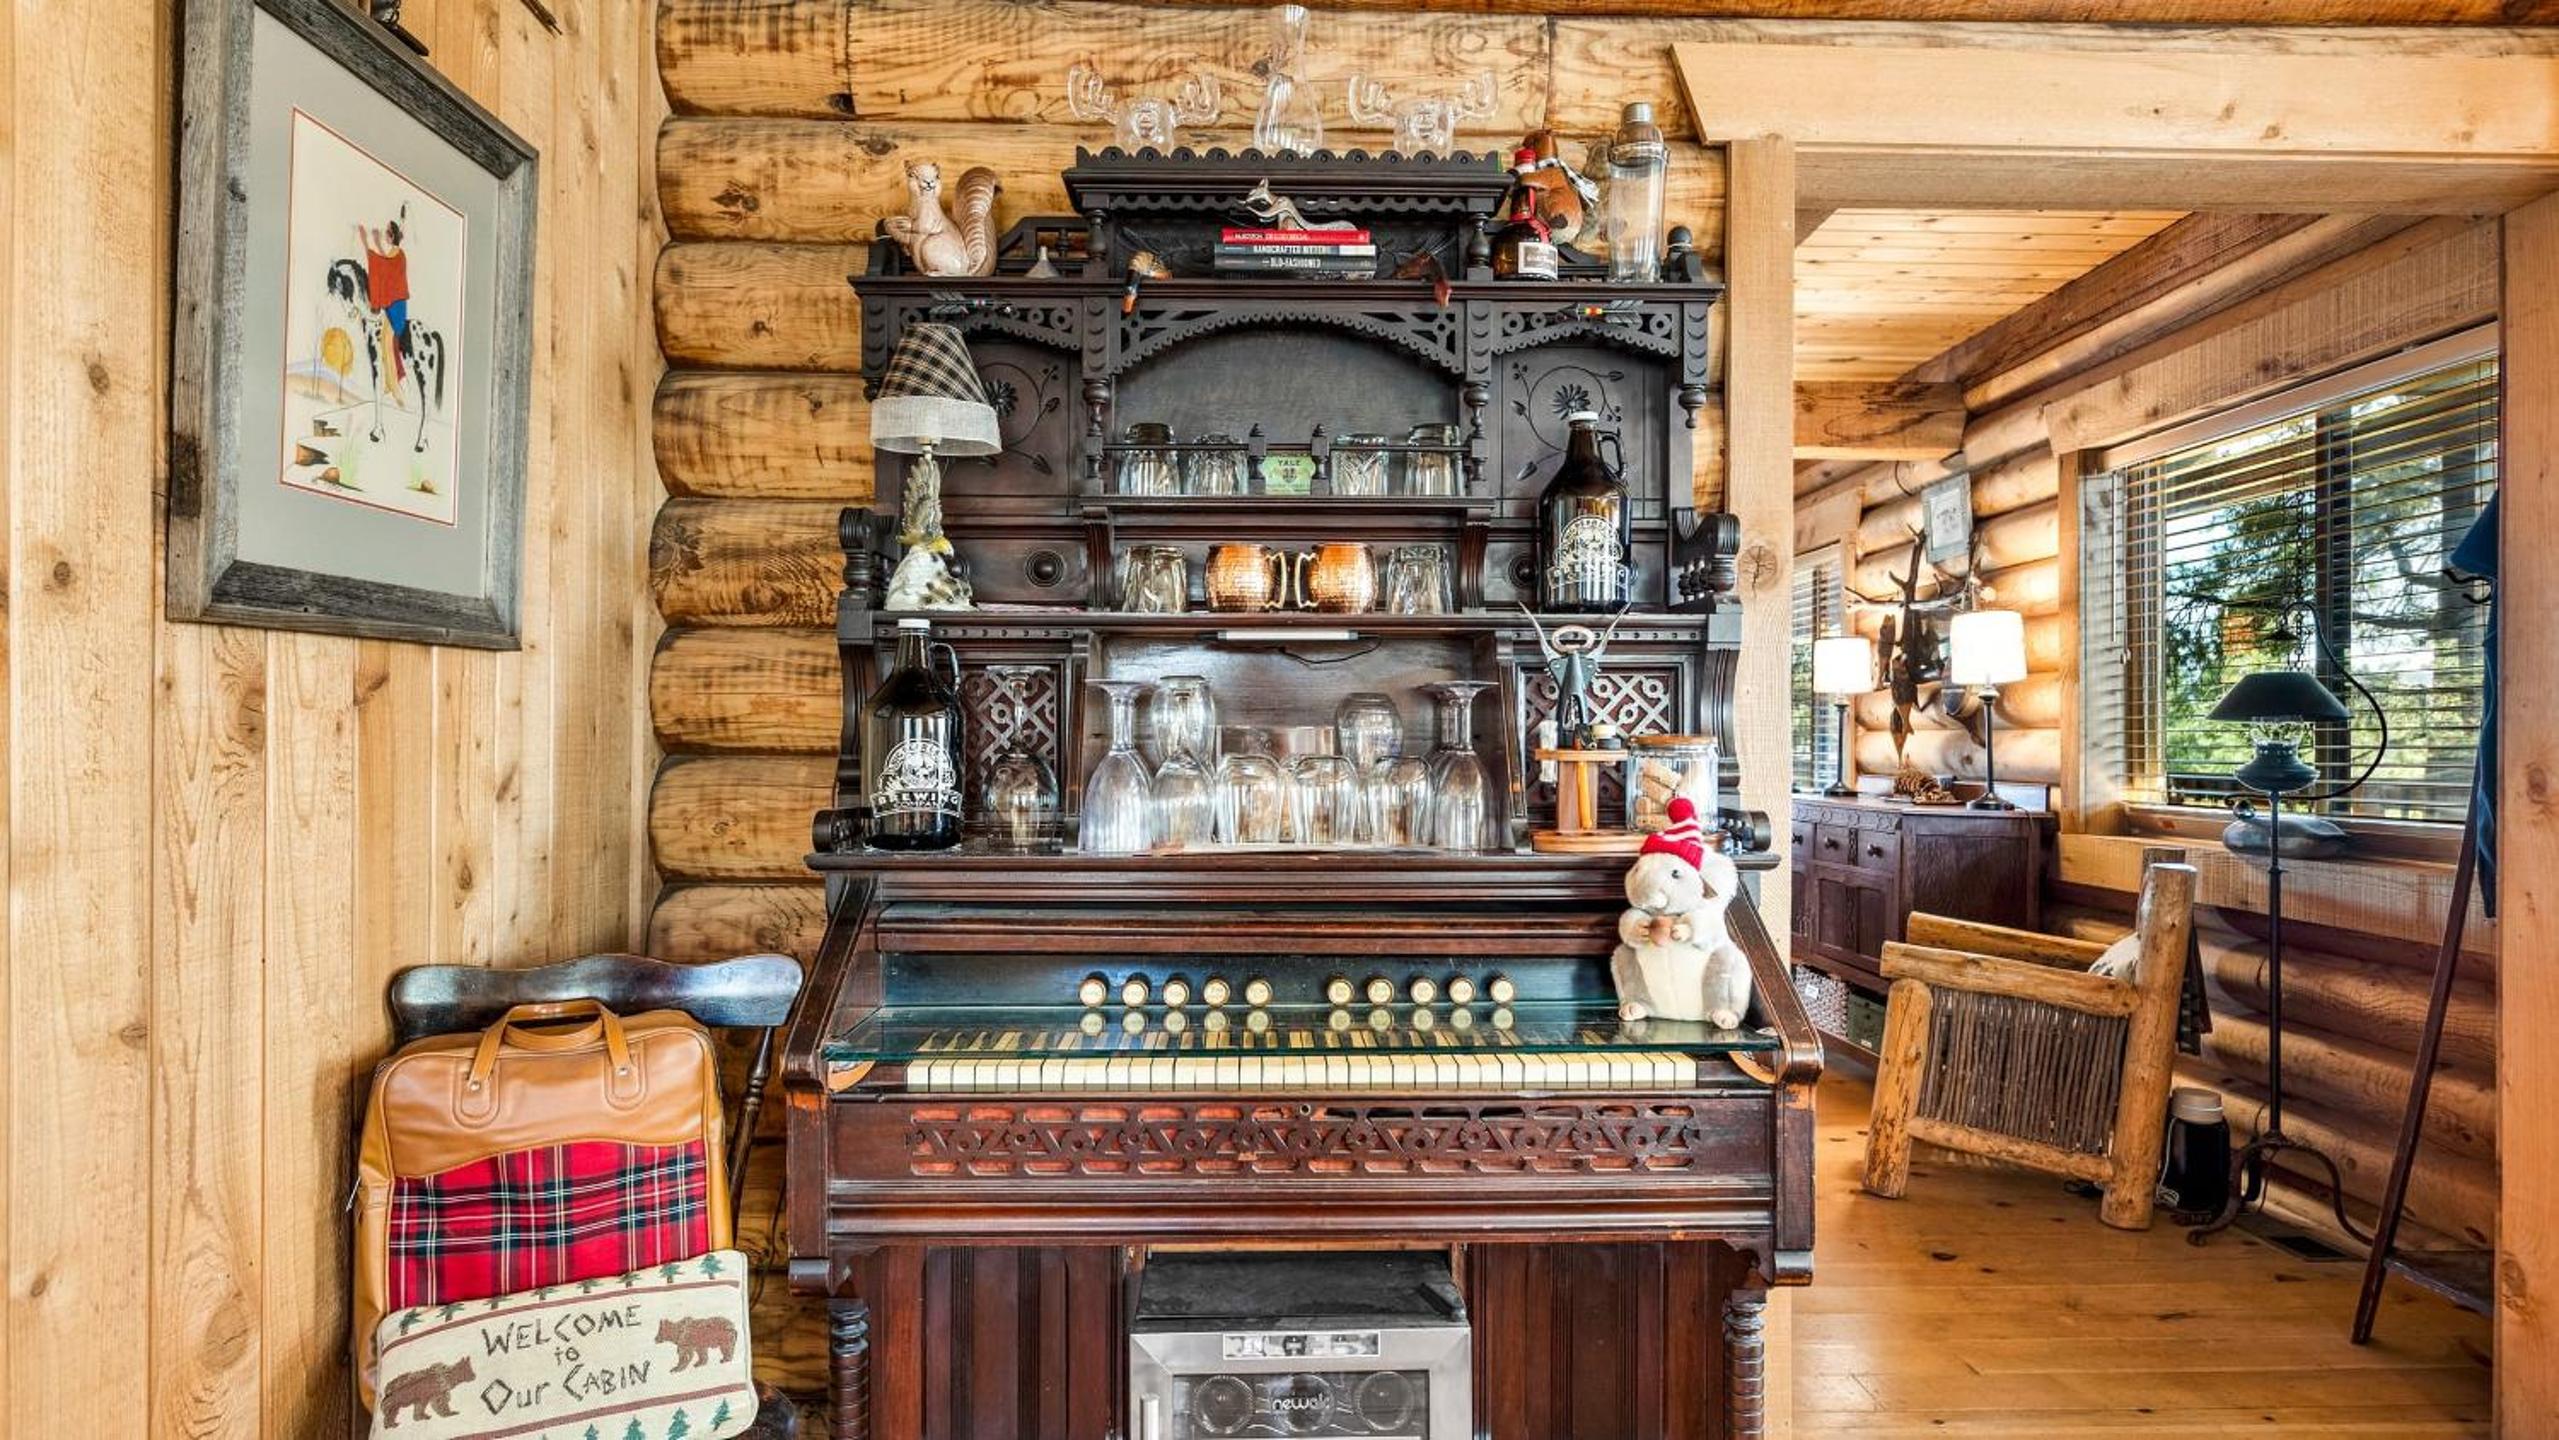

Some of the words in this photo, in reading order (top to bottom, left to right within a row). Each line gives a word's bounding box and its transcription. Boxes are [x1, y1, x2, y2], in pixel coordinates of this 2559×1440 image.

[481, 1304, 642, 1356] WELCOME
[554, 1346, 580, 1366] to
[562, 1360, 651, 1401] CABIN
